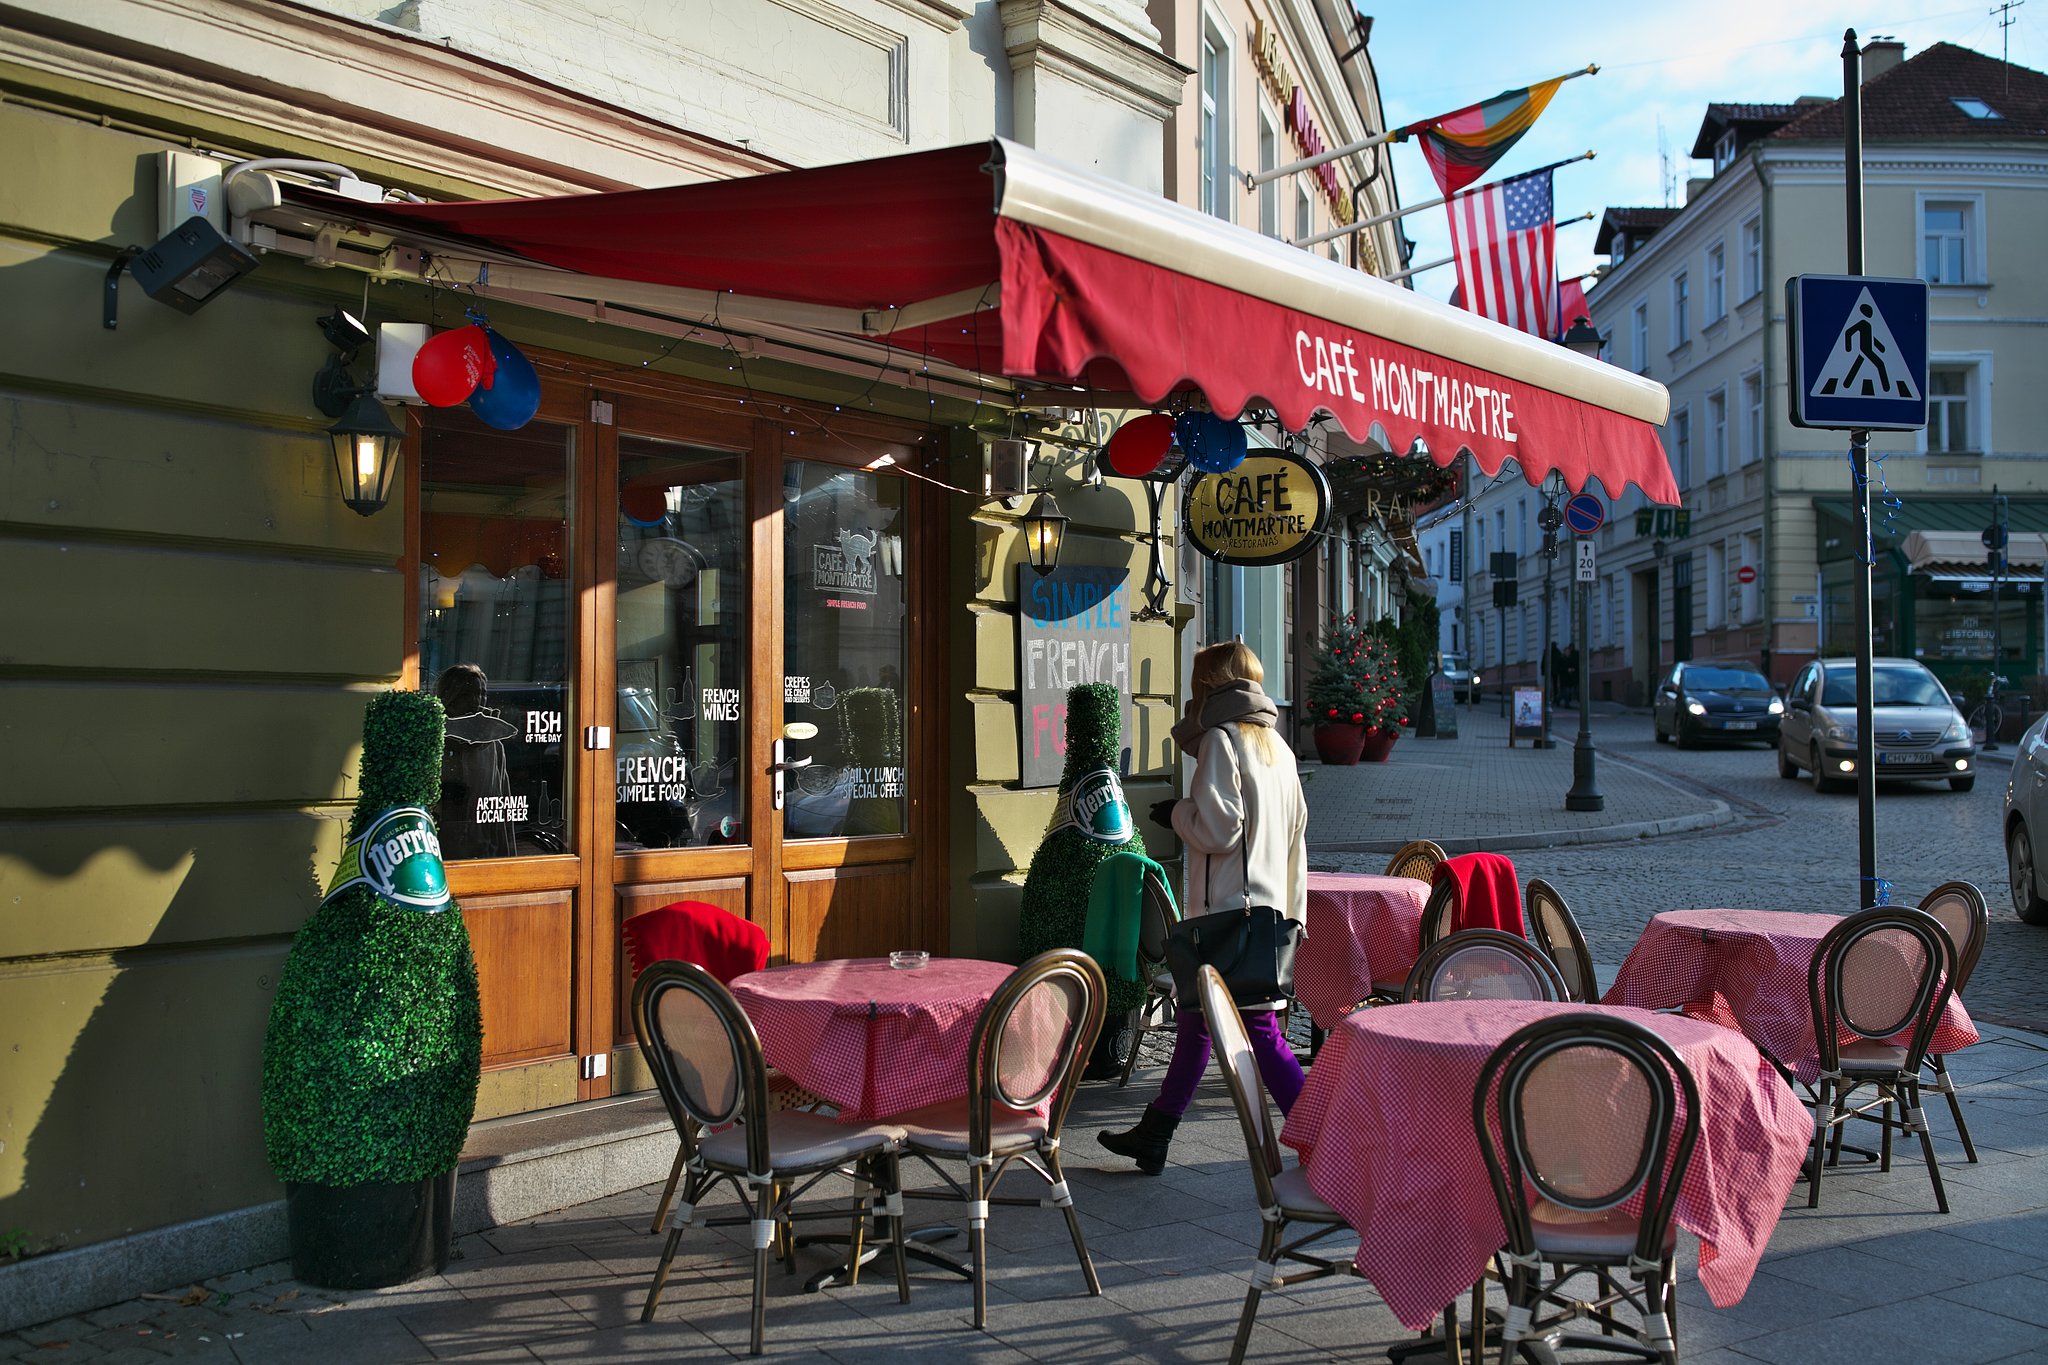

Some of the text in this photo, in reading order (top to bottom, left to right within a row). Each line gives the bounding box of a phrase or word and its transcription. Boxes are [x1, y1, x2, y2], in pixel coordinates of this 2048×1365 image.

[1296, 330, 1518, 443] CAFÉ MONTMARTRE
[1216, 466, 1292, 515] CAFÉ
[1202, 515, 1307, 539] MONTMARTRE
[818, 551, 842, 571] CAFÉ
[1579, 558, 1594, 569] 20
[817, 570, 873, 589] MONTMARTRE
[1581, 570, 1592, 579] m
[1031, 578, 1123, 631] SIMPLE
[1027, 638, 1129, 695] FRENCH
[702, 688, 739, 703] FRENCH
[702, 703, 740, 721] WINES
[526, 711, 561, 733] FISH
[525, 733, 562, 743] OF THE DAY
[616, 756, 686, 783] FRENCH
[842, 767, 904, 783] DAILY LUNCH
[616, 783, 687, 803] SIMPLE FOOD
[842, 783, 904, 799] SPECIAL OFFER
[477, 796, 529, 810] ARTISANAL
[476, 808, 528, 824] LOCAL BEER
